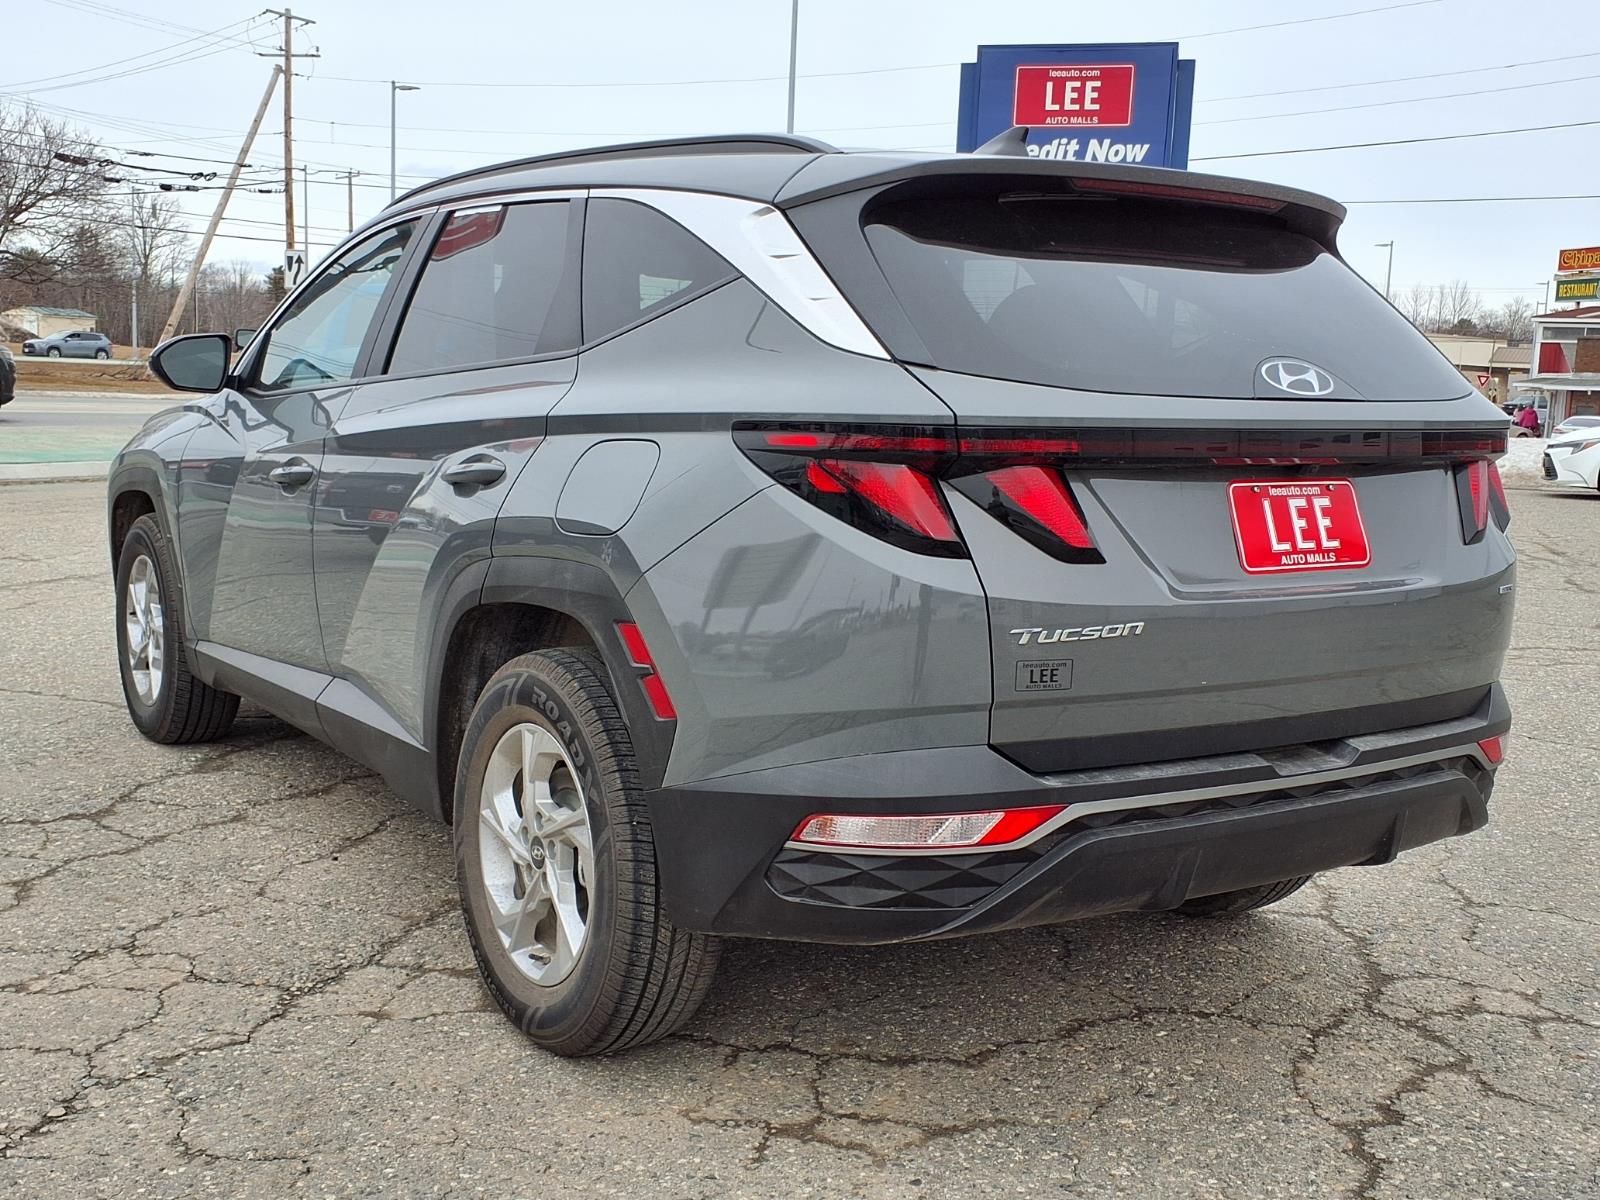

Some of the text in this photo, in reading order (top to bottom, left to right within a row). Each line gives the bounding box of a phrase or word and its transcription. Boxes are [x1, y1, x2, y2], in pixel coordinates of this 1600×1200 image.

[1049, 69, 1100, 77] leeauto.com
[1045, 81, 1101, 110] LEE
[1045, 116, 1098, 124] AUTO MALLS
[1085, 138, 1150, 162] Now
[1558, 282, 1598, 297] RESTAURANT
[1268, 486, 1321, 496] leeauto.com
[1262, 496, 1341, 552] LEE
[1281, 552, 1336, 565] AUTO MALLS
[1030, 668, 1060, 684] LEE
